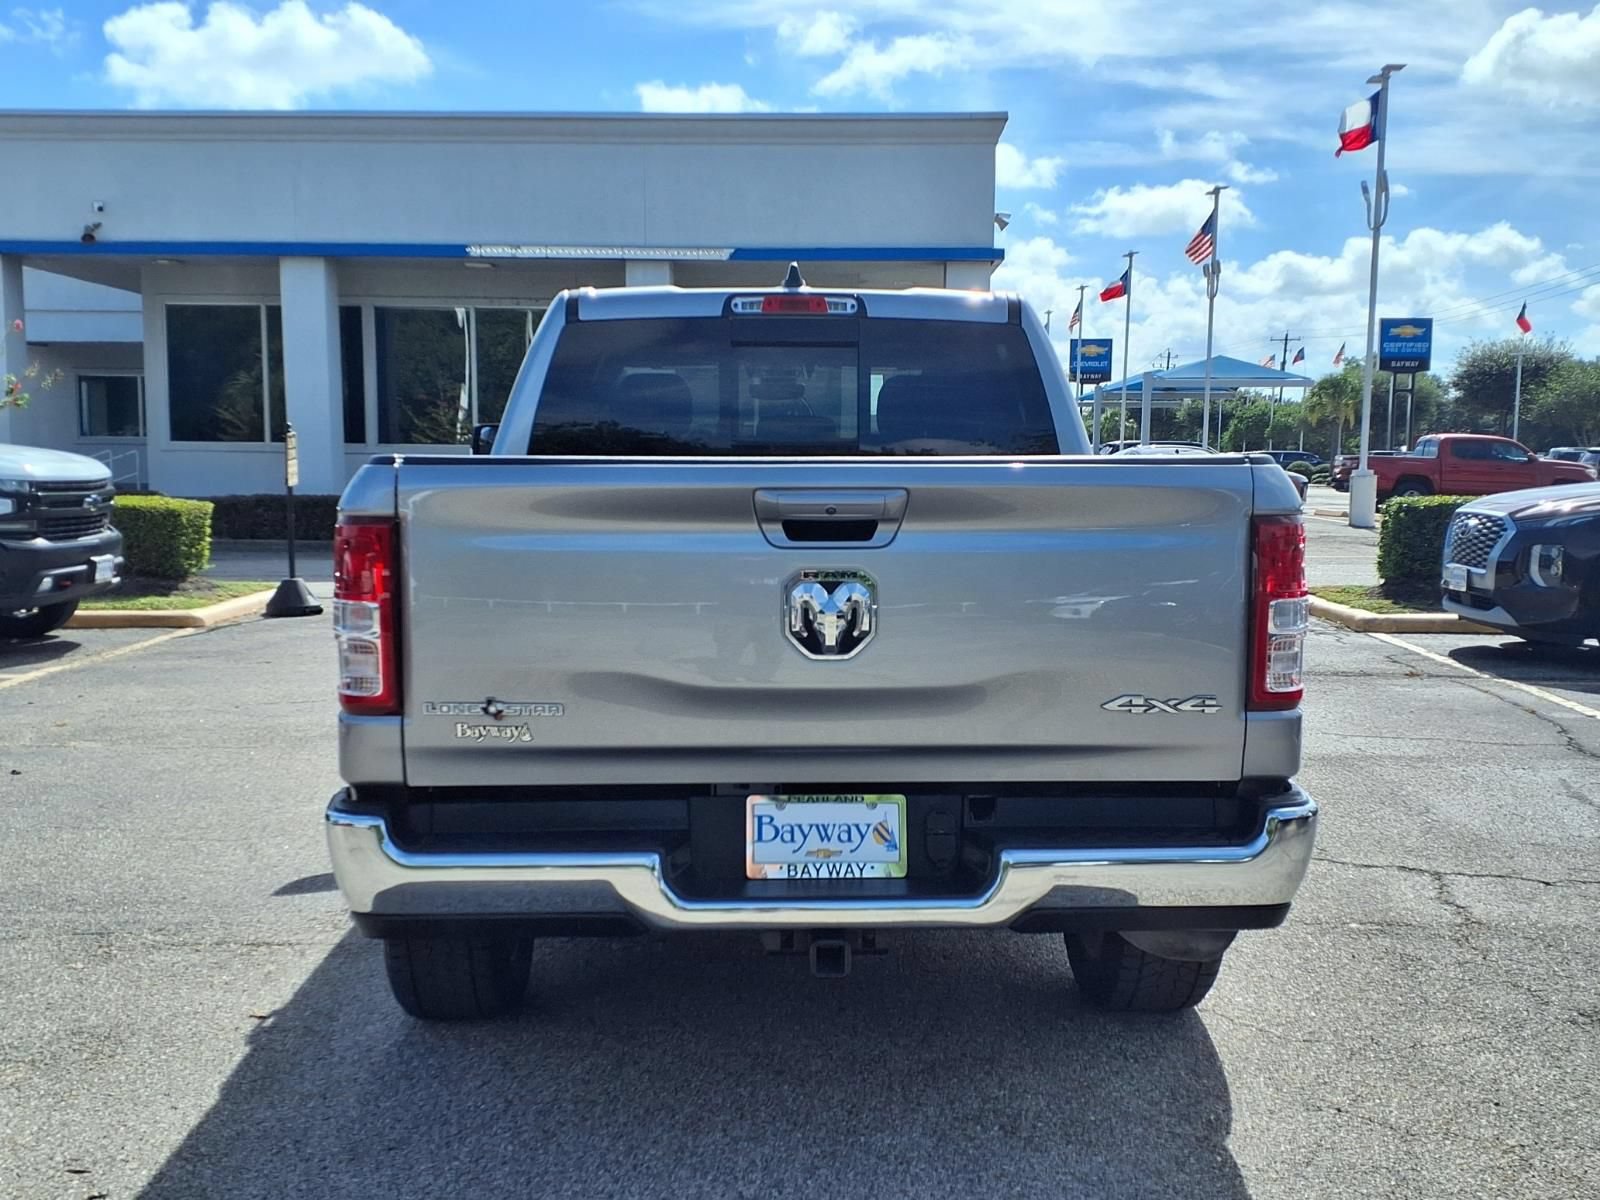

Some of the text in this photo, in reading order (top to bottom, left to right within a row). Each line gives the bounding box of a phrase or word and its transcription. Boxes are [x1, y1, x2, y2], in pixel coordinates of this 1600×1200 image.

[801, 570, 858, 580] RAM
[424, 702, 564, 716] LONE STAR
[755, 814, 871, 853] Bayway
[787, 863, 866, 878] BAYWAY
